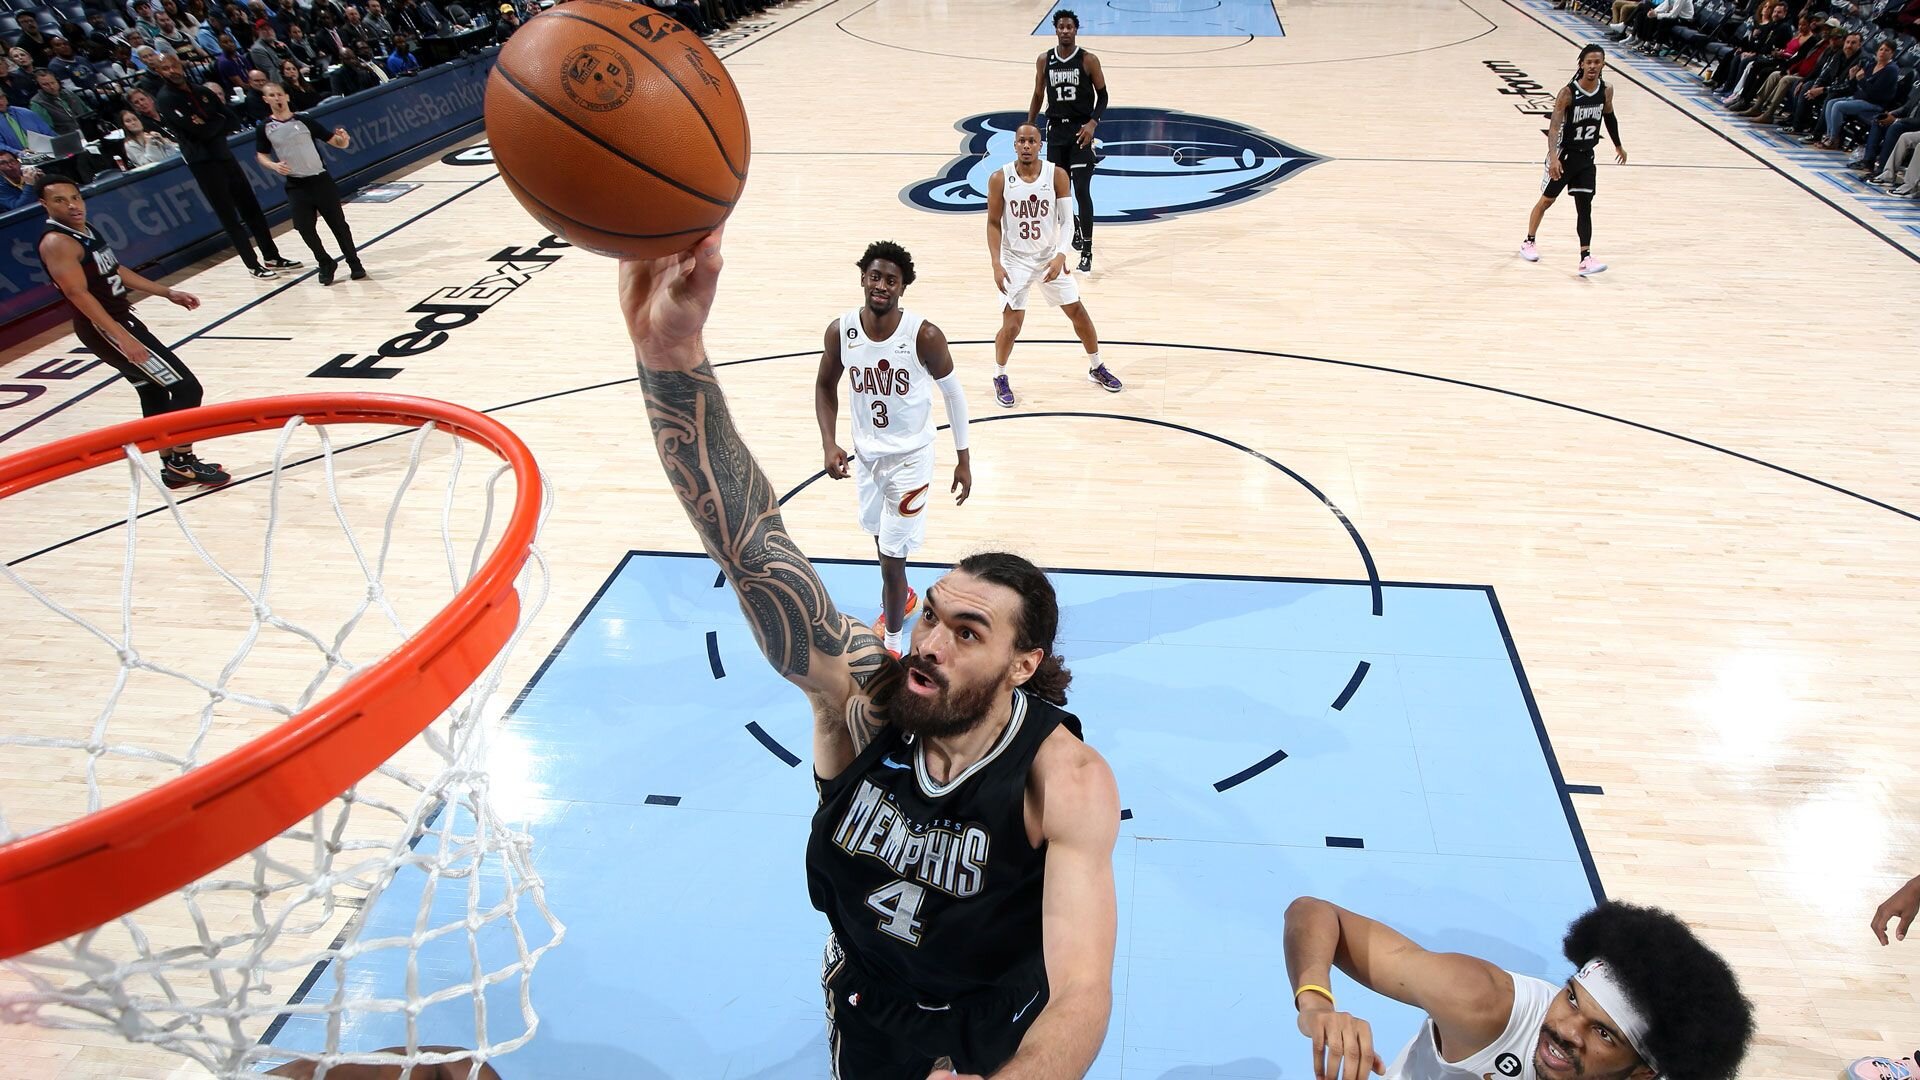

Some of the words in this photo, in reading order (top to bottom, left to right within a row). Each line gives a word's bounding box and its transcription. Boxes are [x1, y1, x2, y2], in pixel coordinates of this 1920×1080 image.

[1048, 68, 1080, 87] MEMPHIS
[1055, 86, 1077, 101] 13
[341, 71, 487, 155] rizzliesBankin
[1573, 125, 1597, 140] 12
[128, 181, 213, 236] GIFT
[1010, 198, 1050, 218] CAVS
[1018, 221, 1042, 241] 35
[849, 329, 856, 338] 6
[849, 366, 910, 397] CAVS
[870, 400, 889, 428] 3
[832, 779, 990, 899] MEMPHIS
[864, 879, 927, 947] 4
[1499, 1056, 1517, 1074] 6
